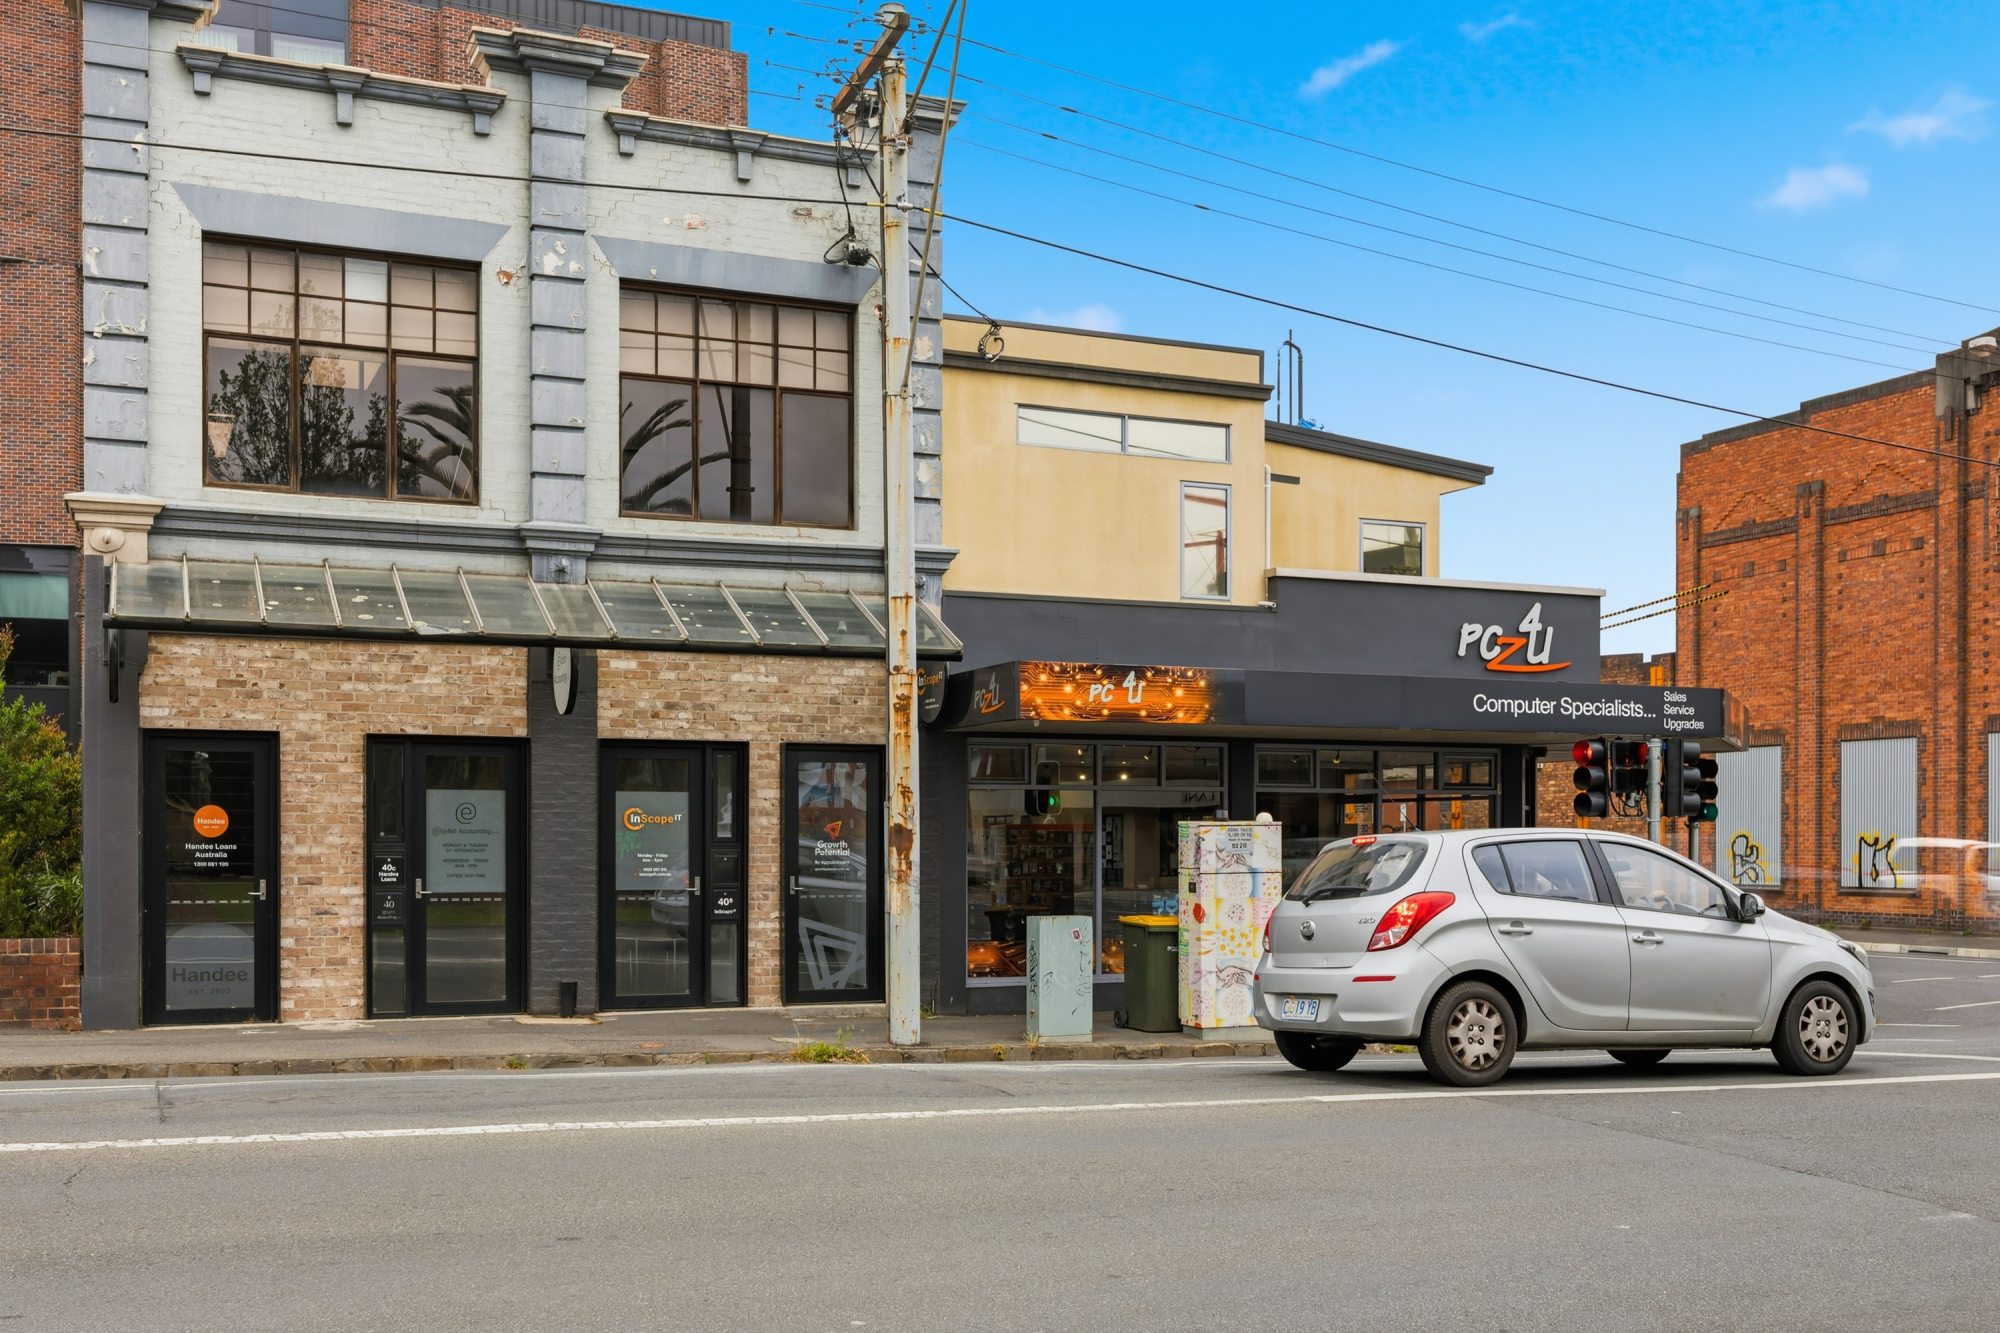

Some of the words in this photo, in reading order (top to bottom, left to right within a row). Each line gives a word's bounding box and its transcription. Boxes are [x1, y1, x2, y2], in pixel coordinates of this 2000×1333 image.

[1663, 690, 1687, 702] Sales
[1473, 694, 1556, 718] Computer
[1663, 703, 1695, 715] Service
[1663, 717, 1705, 731] Upgrades
[630, 813, 674, 826] InScope
[817, 840, 848, 848] Growth
[814, 848, 850, 856] Potential
[383, 900, 395, 909] 40
[172, 967, 248, 982] Handee
[210, 987, 231, 995] 2002
